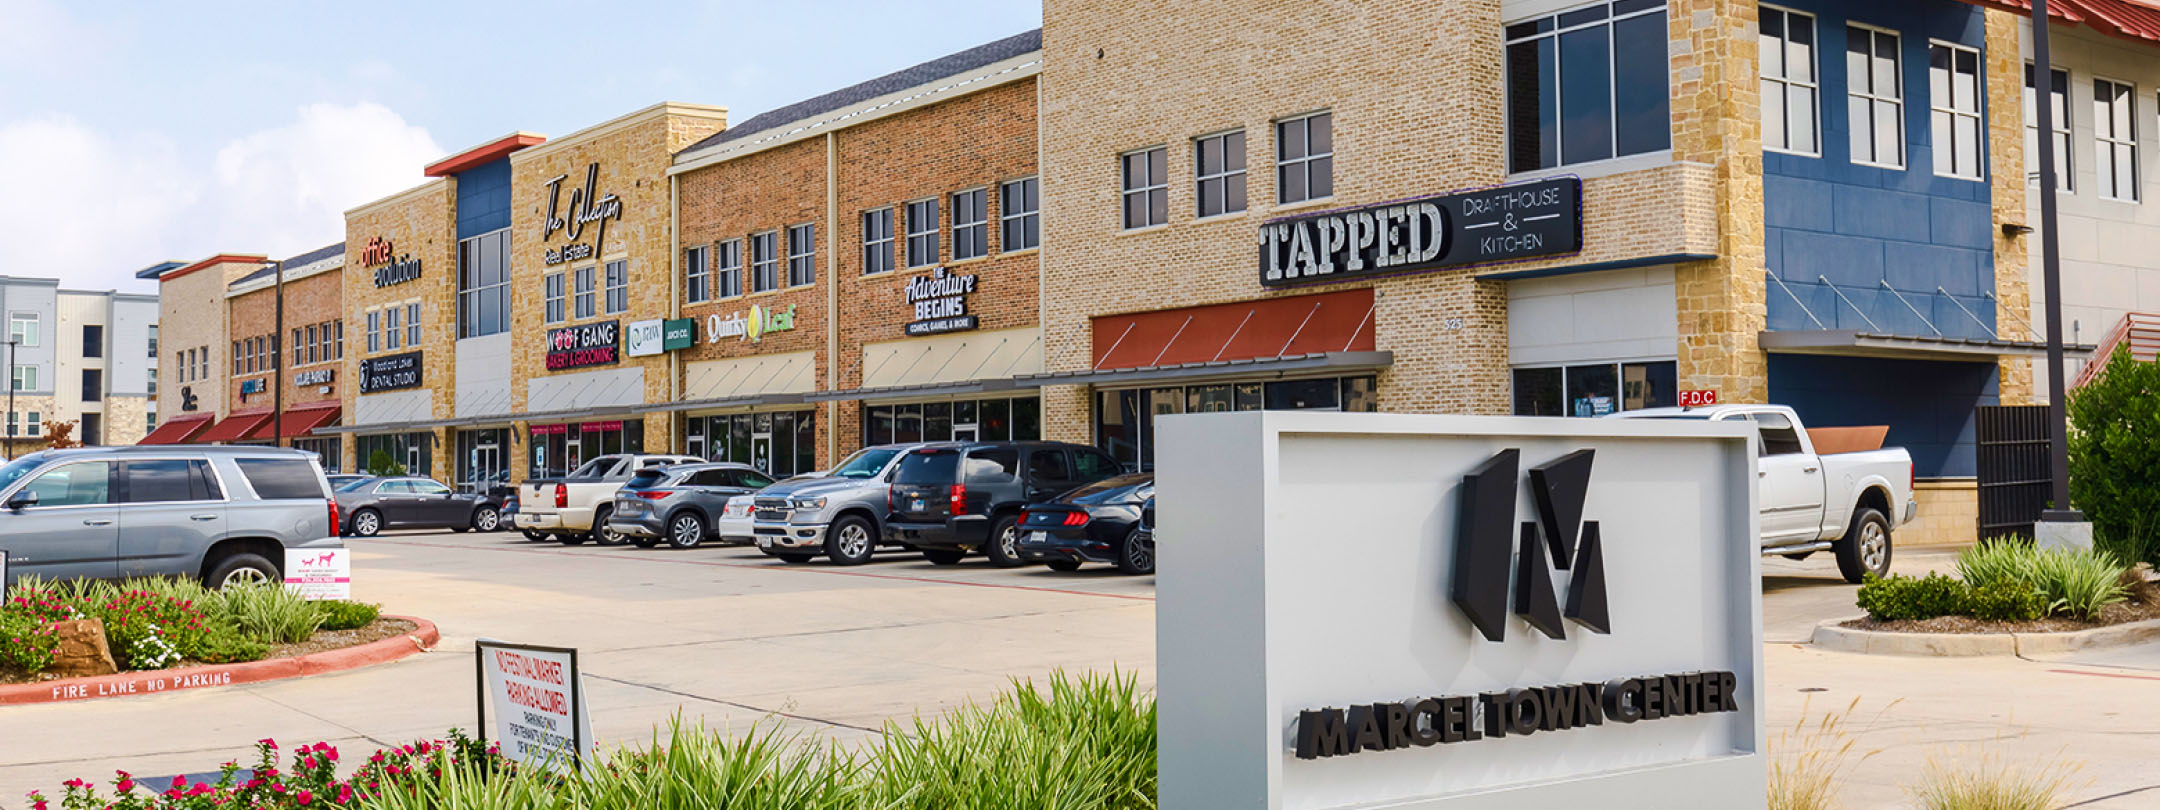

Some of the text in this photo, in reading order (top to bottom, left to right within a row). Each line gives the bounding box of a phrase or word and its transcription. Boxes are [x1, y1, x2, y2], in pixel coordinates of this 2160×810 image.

[543, 163, 622, 259] The Collection
[1503, 213, 1518, 231] &
[545, 249, 563, 264] Real
[564, 244, 592, 260] Estate
[1259, 203, 1443, 280] TAPPED
[904, 273, 976, 305] Adventure
[915, 296, 966, 321] BEGINS
[581, 324, 614, 347] GANG
[708, 304, 796, 343] Quirky Leaf
[574, 347, 613, 365] GROOMING
[53, 672, 230, 699] FIRE LANE NO PARKING
[1295, 671, 1738, 760] MARCEL TOWN CENTER
